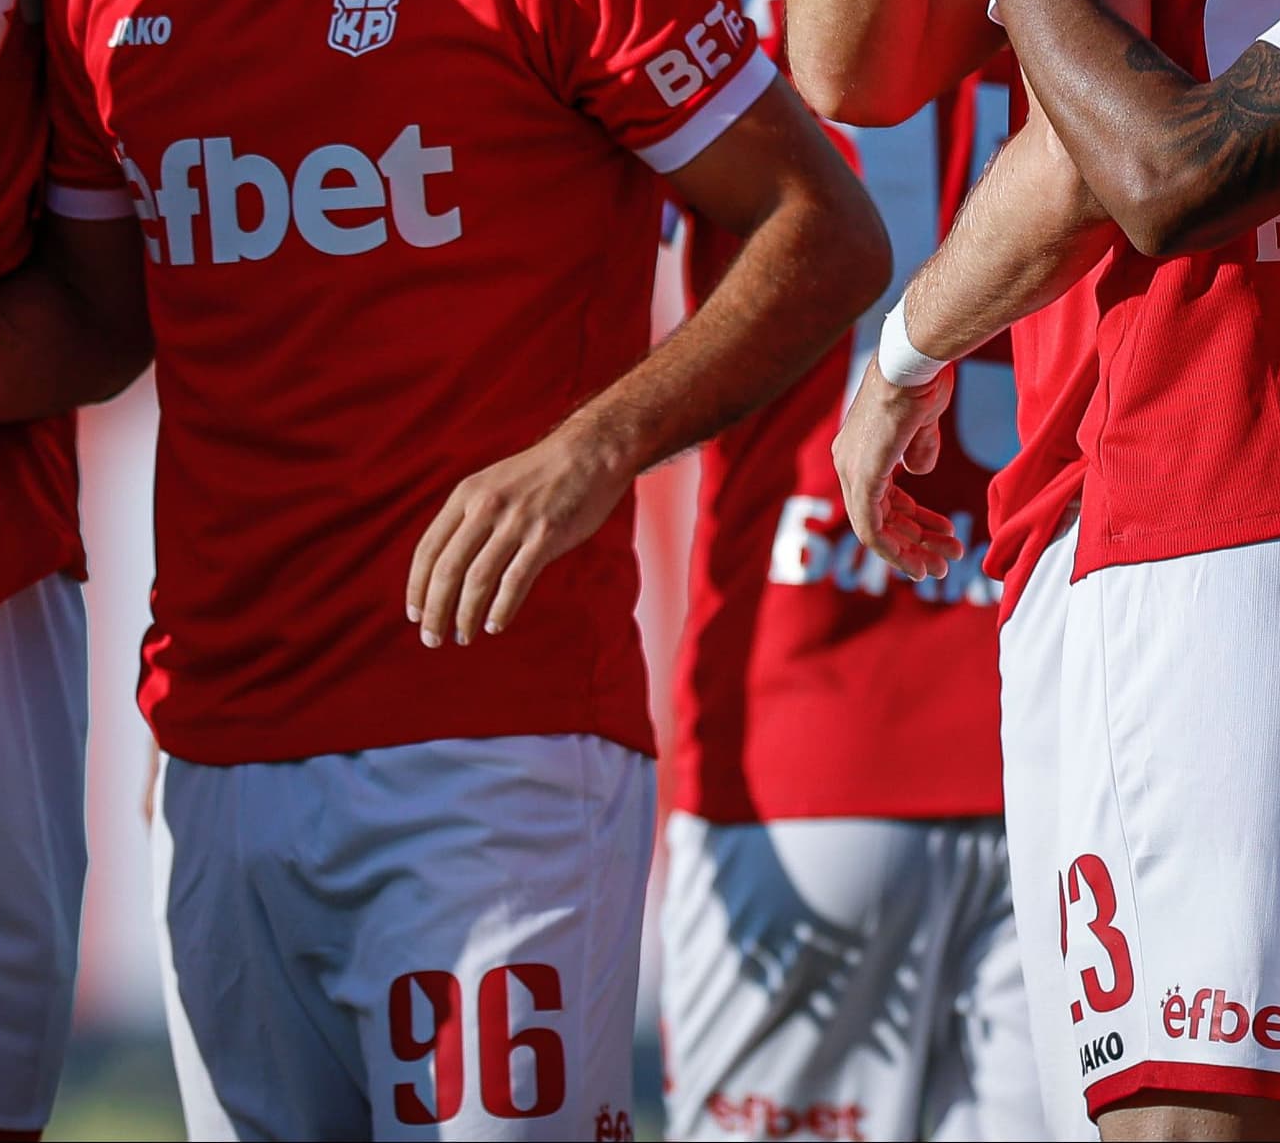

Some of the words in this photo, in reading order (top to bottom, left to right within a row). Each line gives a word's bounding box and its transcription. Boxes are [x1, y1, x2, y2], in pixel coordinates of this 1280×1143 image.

[107, 15, 172, 48] JAKO
[1058, 853, 1135, 1025] 3
[389, 963, 566, 1125] 96
